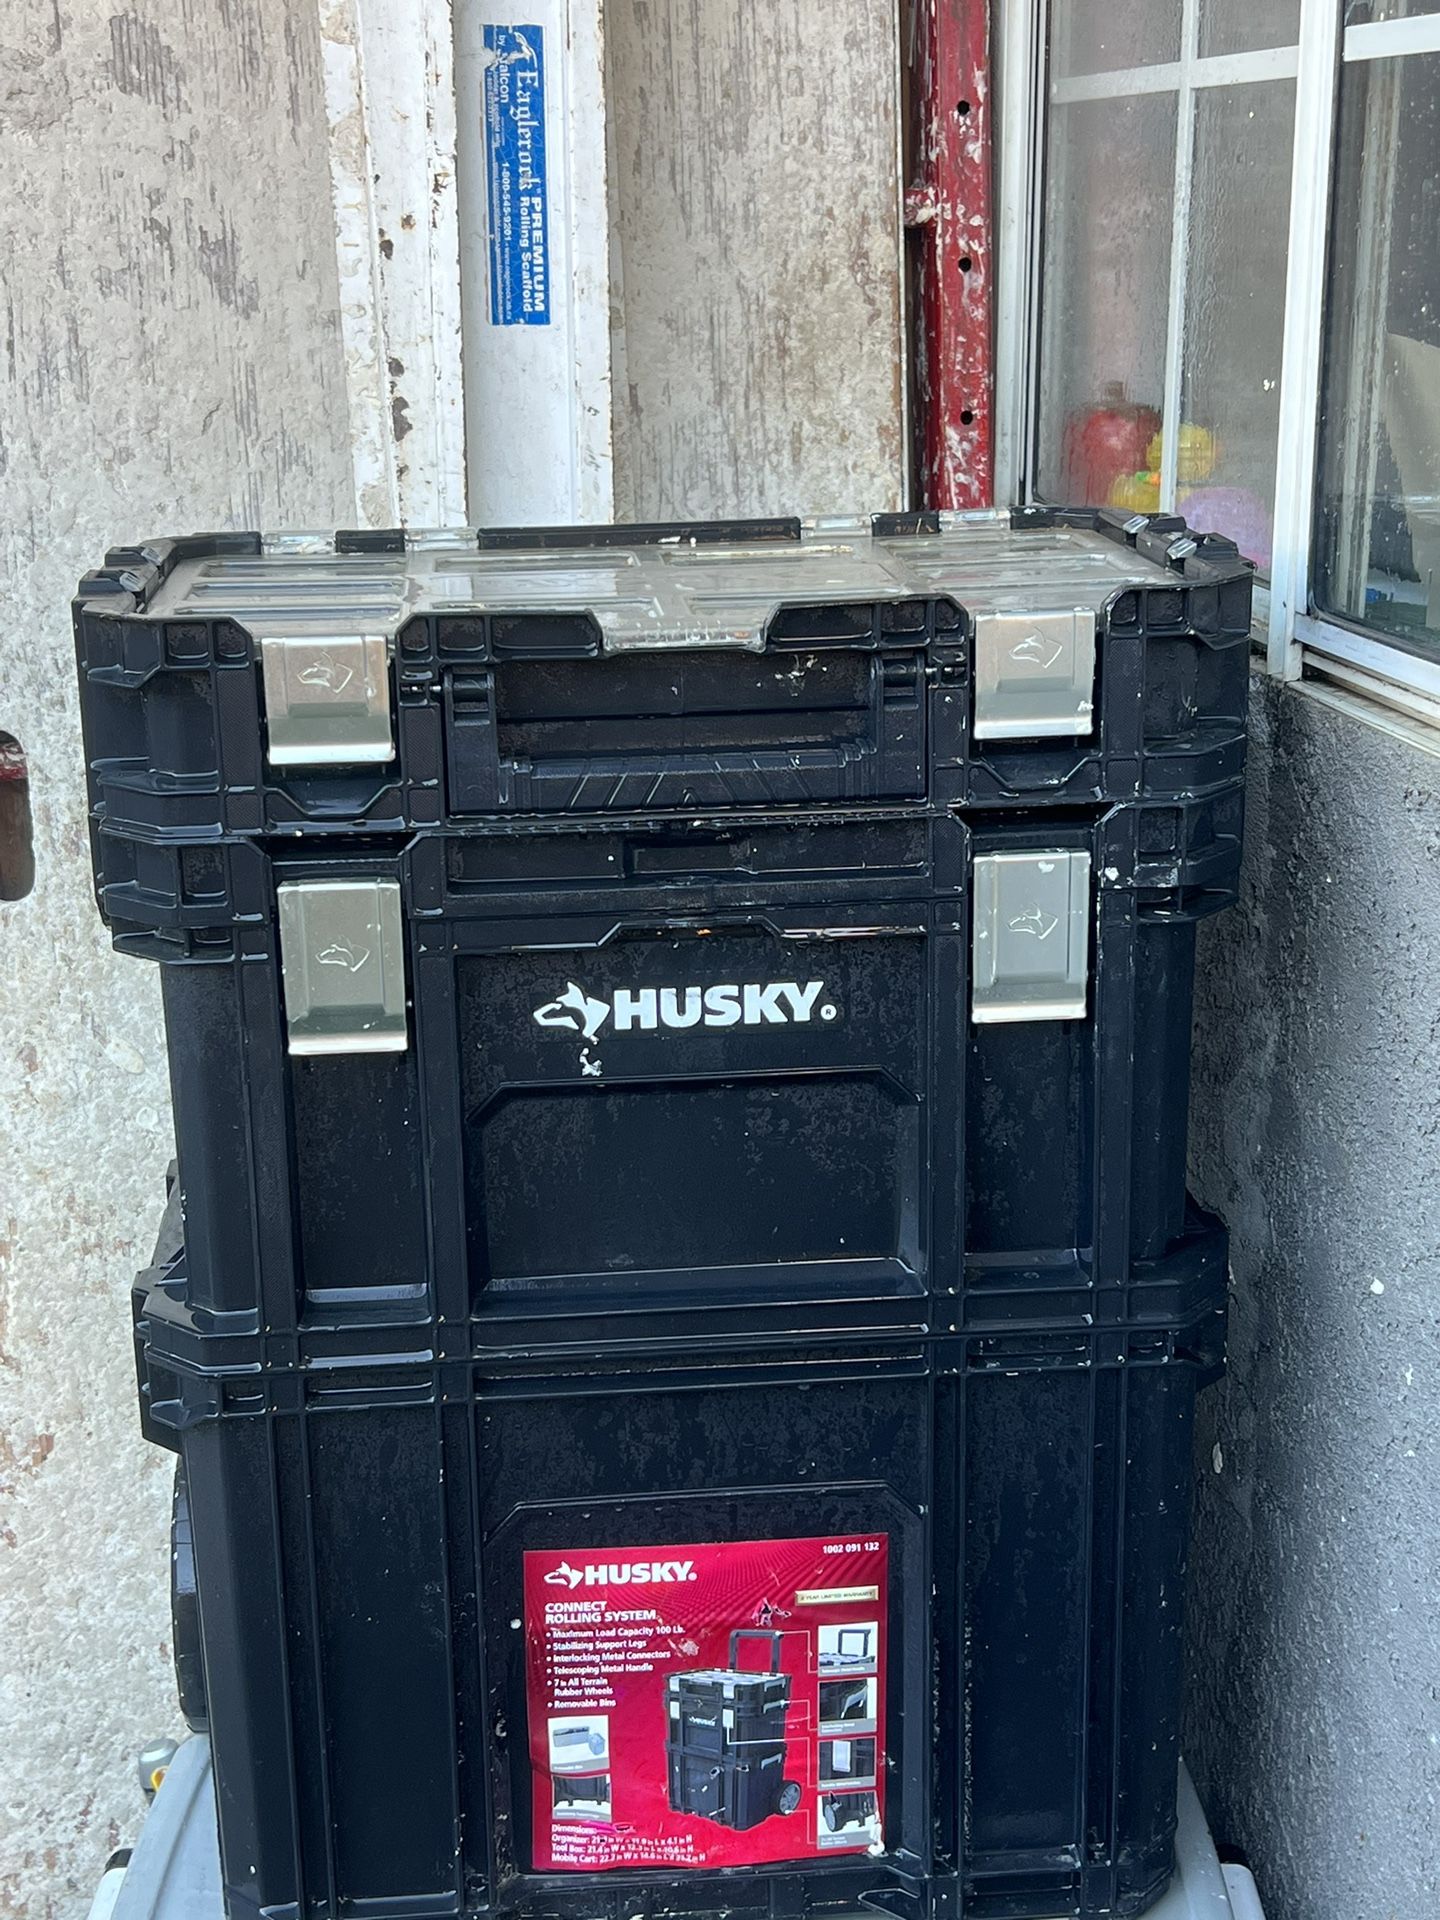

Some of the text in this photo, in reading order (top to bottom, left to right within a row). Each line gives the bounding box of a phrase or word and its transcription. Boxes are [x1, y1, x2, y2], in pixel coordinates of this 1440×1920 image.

[497, 35, 507, 46] by
[509, 70, 540, 191] Eaglerock
[502, 161, 511, 241] 1-800-545-9201
[519, 196, 533, 312] Rolling Scaffold
[531, 196, 545, 312] PREMIUM
[613, 981, 824, 1031] HUSKY
[823, 1541, 880, 1554] 1002 091 132
[585, 1561, 694, 1586] HUSKY
[545, 1601, 607, 1613] CONNECT
[545, 1609, 656, 1625] ROLLING SYSTEM
[553, 1624, 686, 1639] Maximum Load Capacity 100 Lb.
[553, 1640, 647, 1651] Stabilizing Support Legs
[553, 1650, 671, 1663] Interlocking Metal Connectors
[553, 1662, 653, 1675] Telescoping Metal Handle
[554, 1679, 560, 1687] 7
[567, 1678, 580, 1686] All
[580, 1677, 608, 1686] Terrain
[554, 1686, 613, 1697] Rubber Wheels
[554, 1698, 616, 1709] Removable Bins
[551, 1833, 590, 1844] Organizer:
[685, 1834, 693, 1844] H
[552, 1843, 568, 1852] Tool
[611, 1844, 620, 1852] W
[686, 1844, 694, 1853] H
[552, 1852, 578, 1863] Mobile
[623, 1852, 633, 1860] W
[699, 1853, 706, 1862] H
